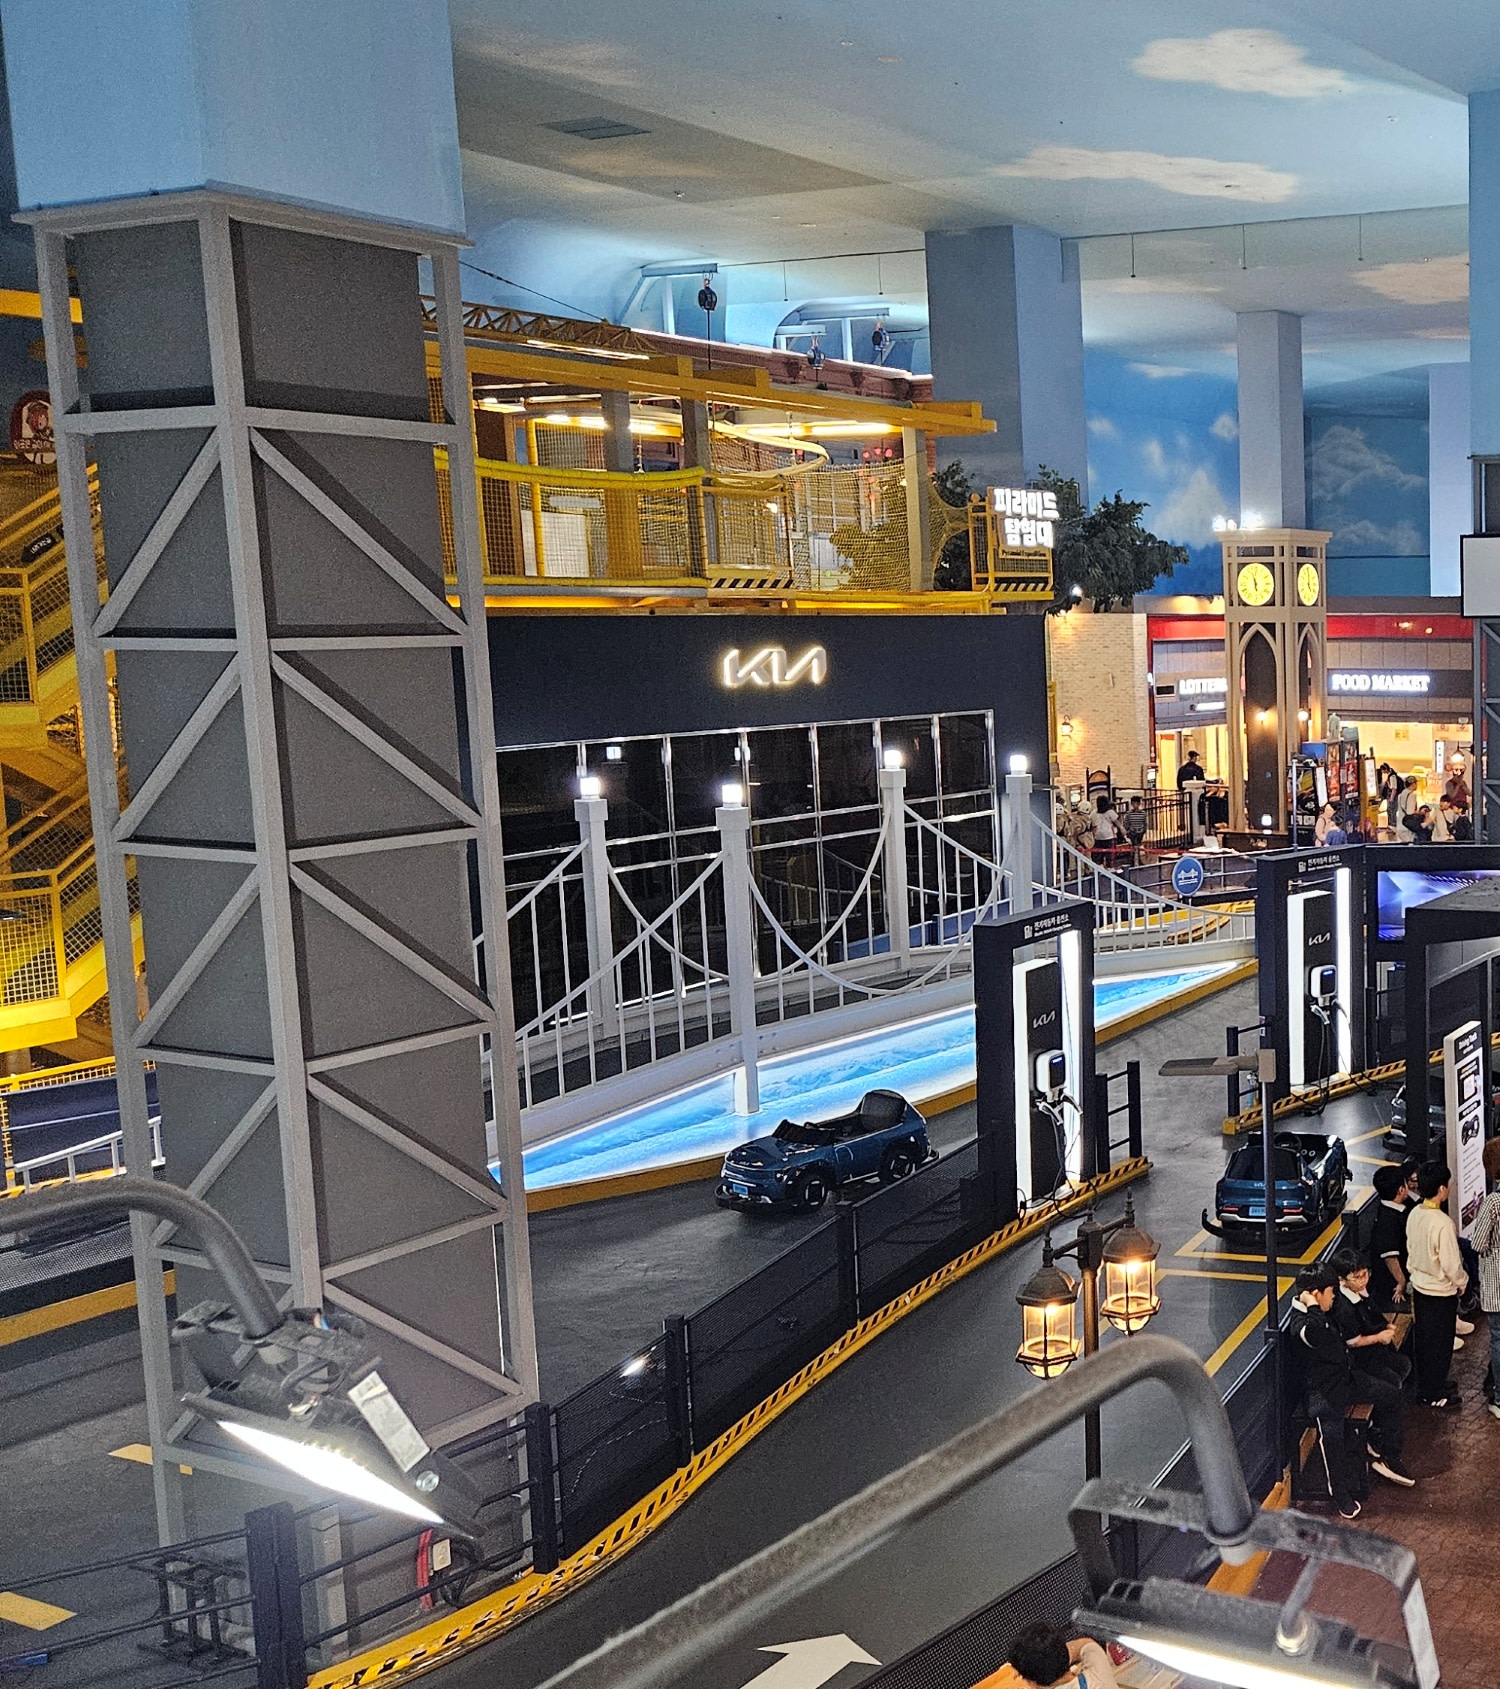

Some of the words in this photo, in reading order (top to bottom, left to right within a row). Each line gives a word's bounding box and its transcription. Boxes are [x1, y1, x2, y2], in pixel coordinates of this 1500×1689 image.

[994, 488, 1059, 519] 피라미드
[1005, 517, 1053, 548] 탐험대
[724, 647, 827, 687] KIA
[1332, 673, 1371, 691] FOOD
[1371, 674, 1430, 692] MARKET
[1309, 932, 1330, 946] KIA
[1033, 1010, 1056, 1028] KIA
